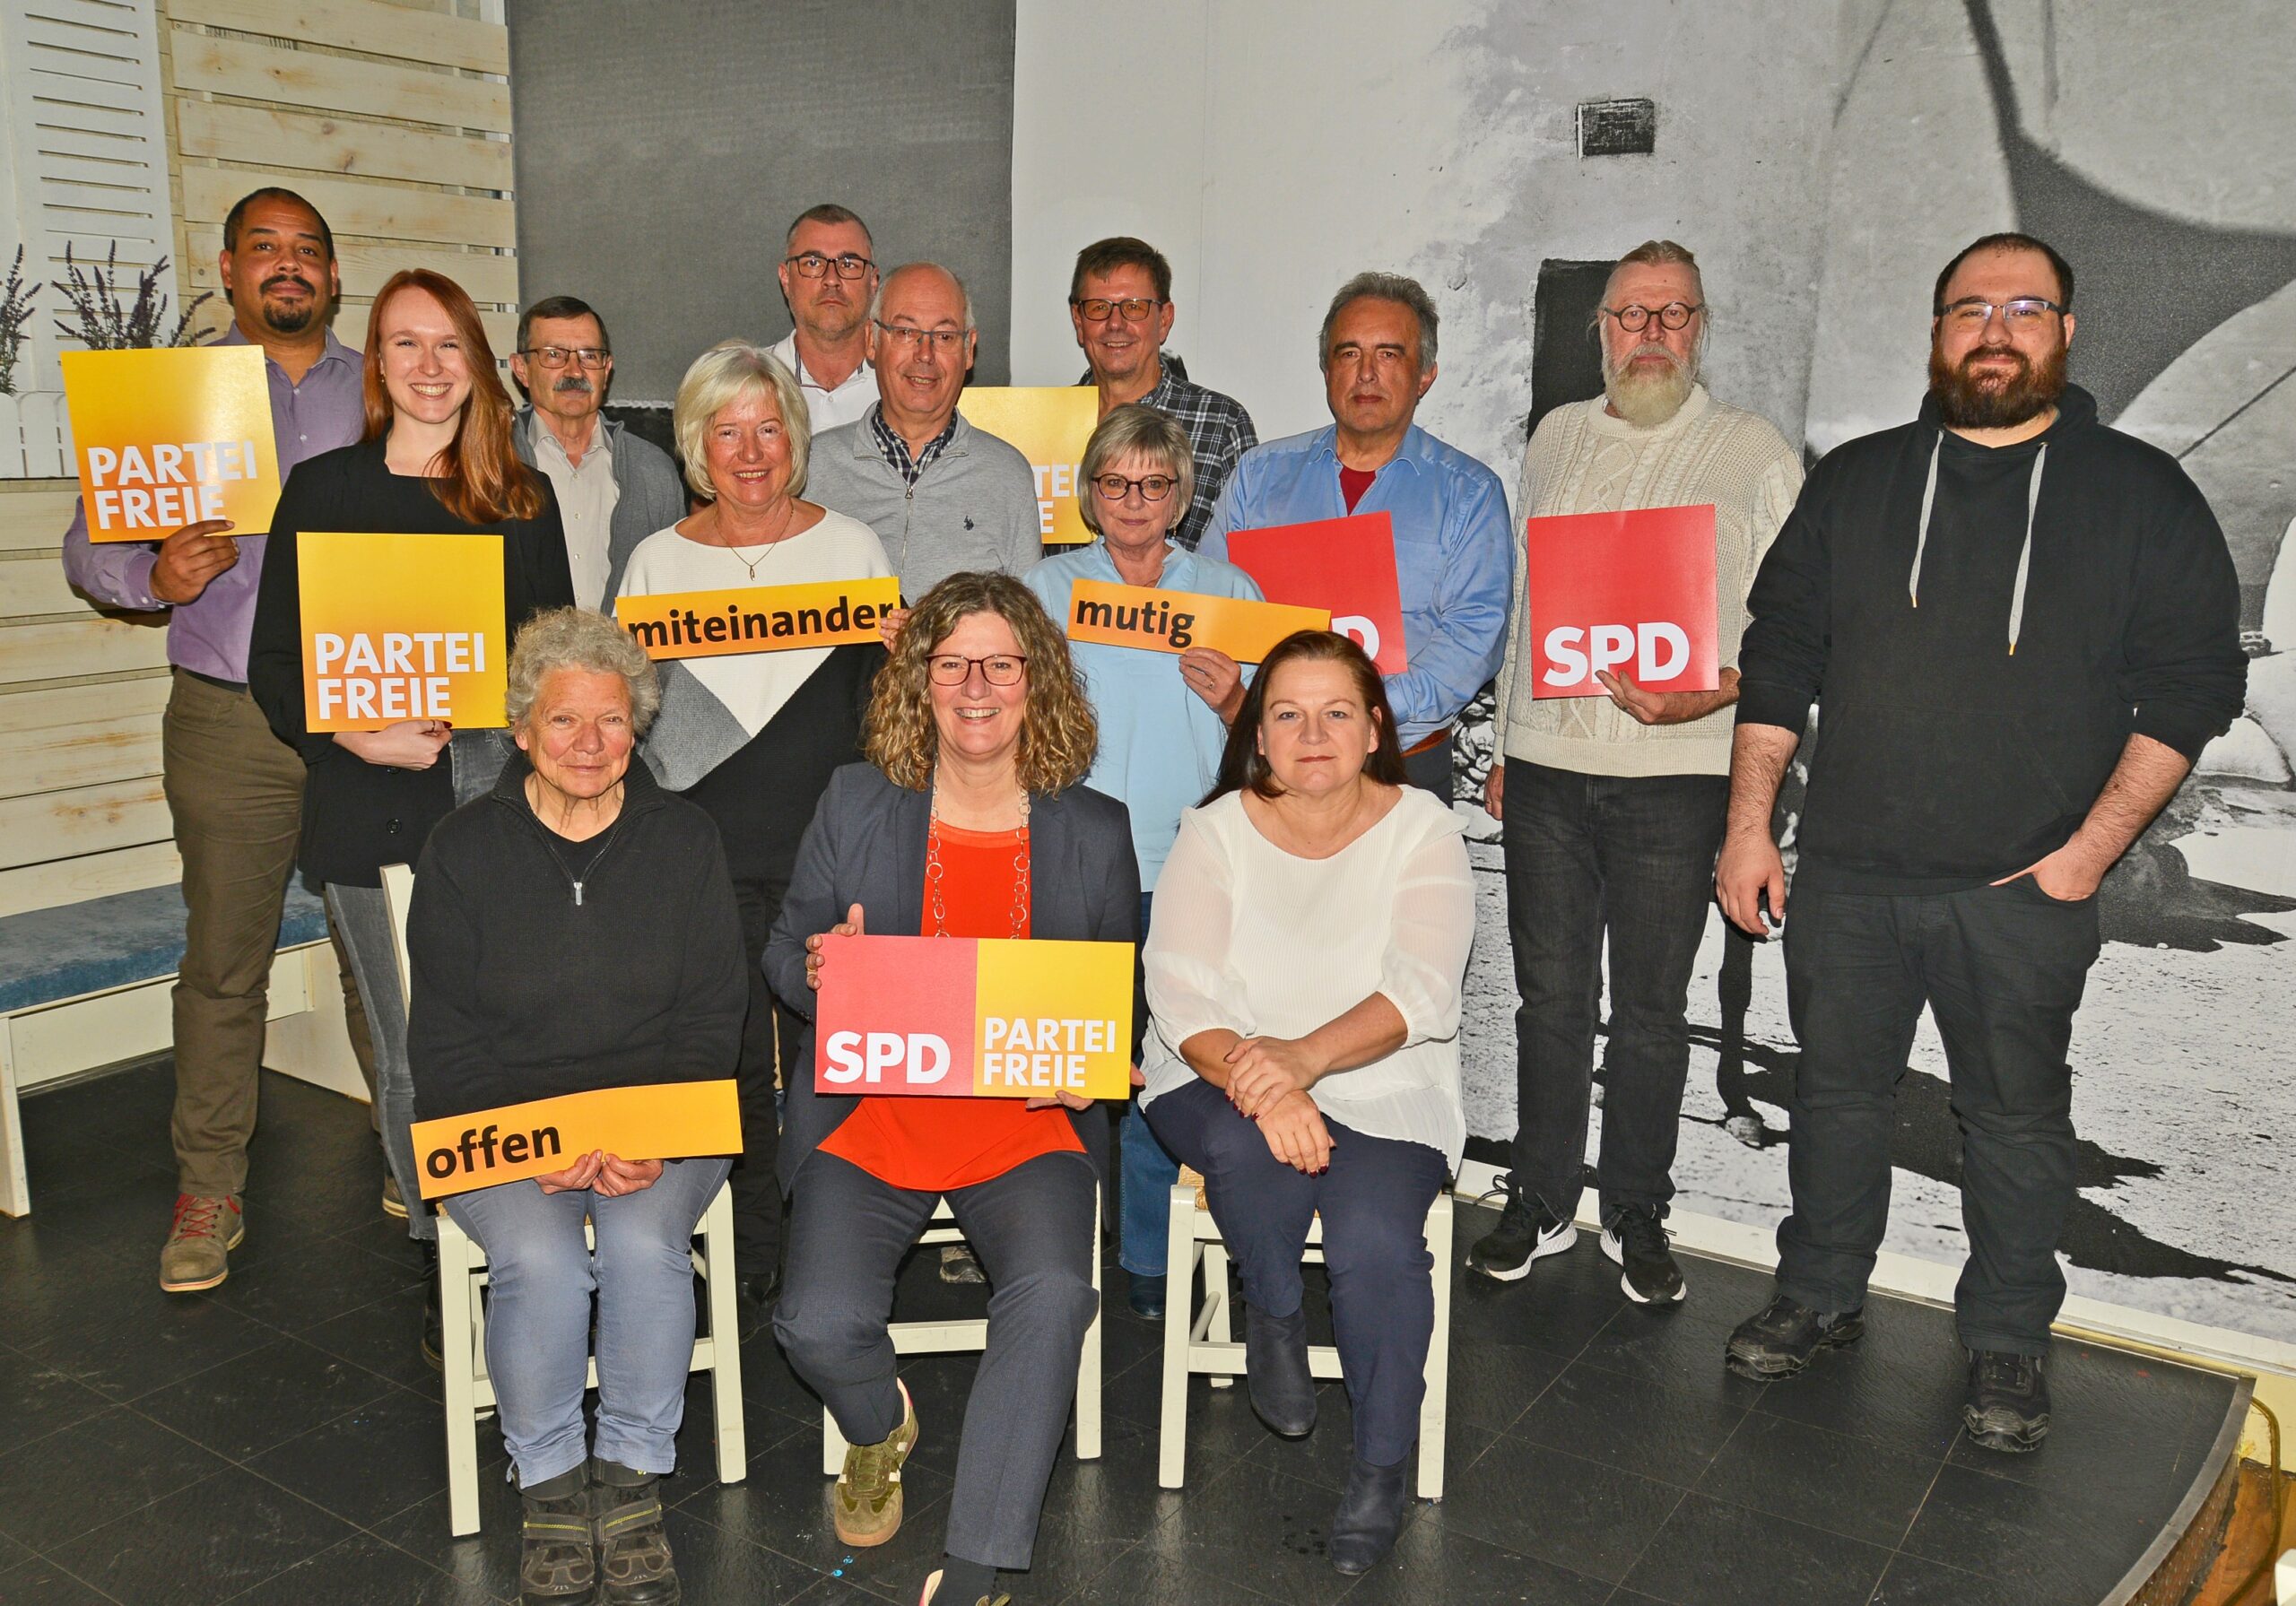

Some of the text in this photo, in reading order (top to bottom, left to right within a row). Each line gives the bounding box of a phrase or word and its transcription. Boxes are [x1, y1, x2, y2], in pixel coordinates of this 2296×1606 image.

[87, 440, 257, 487] PARTEI
[94, 485, 226, 530] FREIE
[628, 595, 893, 647] miteinander
[1076, 600, 1195, 648] mutig
[315, 632, 485, 674] PARTEI
[1543, 621, 1691, 687] SPD
[317, 677, 452, 720] FREIE
[823, 1030, 951, 1084] SPD
[985, 1017, 1116, 1053] PARTEI
[983, 1053, 1086, 1088] FREIE
[426, 1124, 561, 1179] offen
